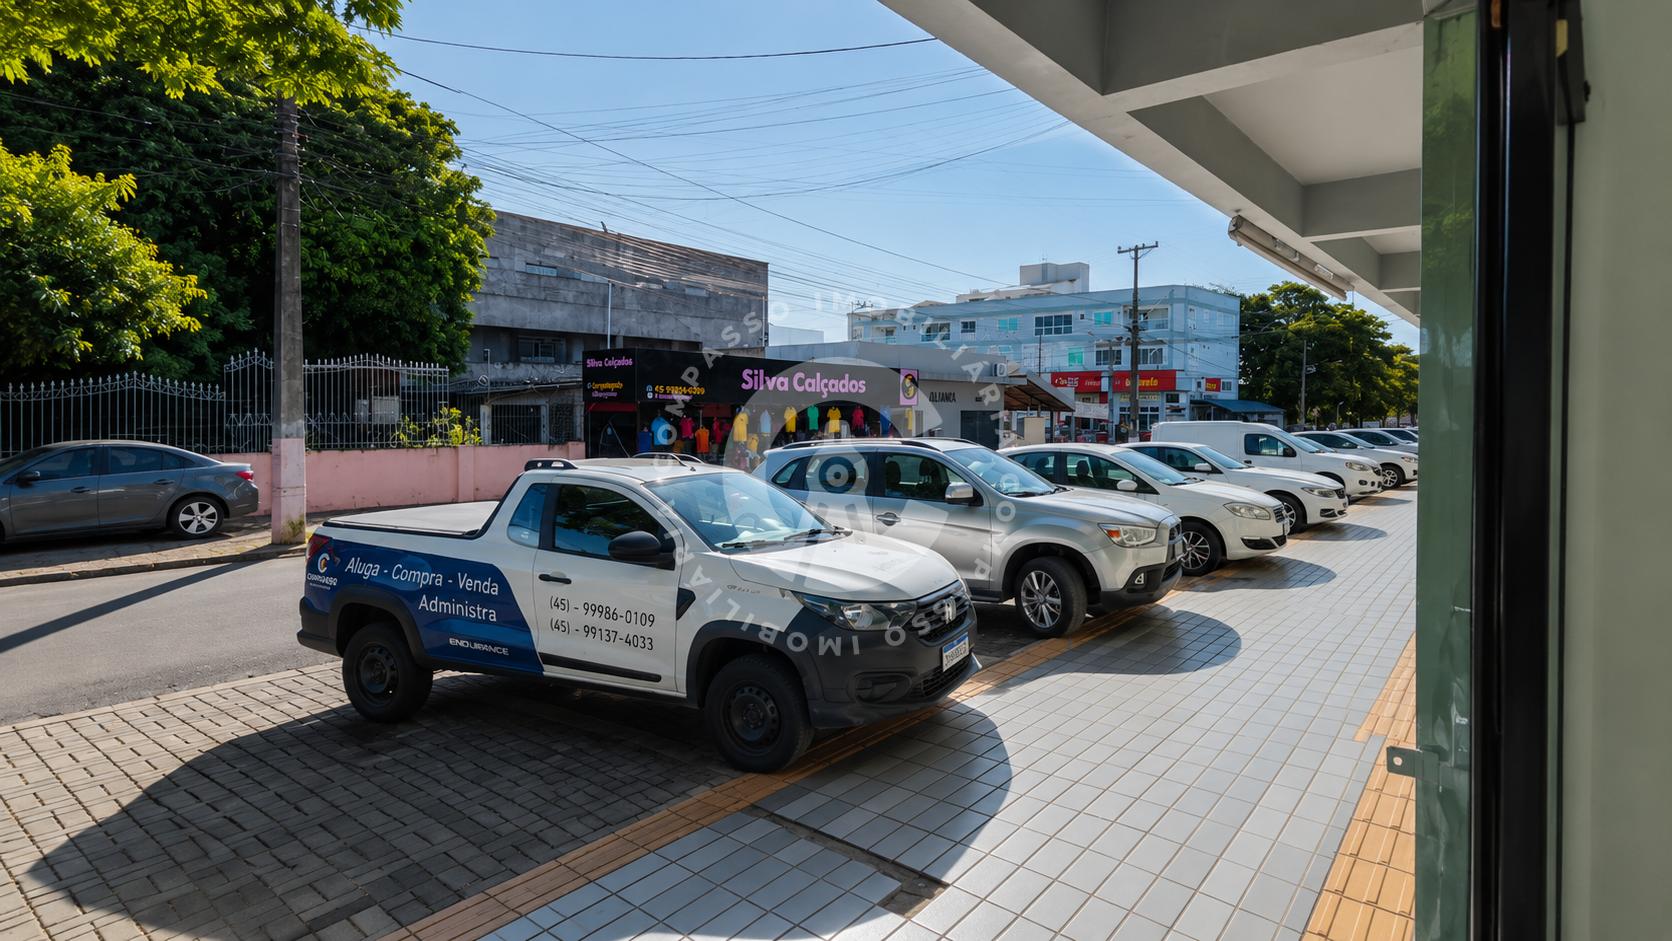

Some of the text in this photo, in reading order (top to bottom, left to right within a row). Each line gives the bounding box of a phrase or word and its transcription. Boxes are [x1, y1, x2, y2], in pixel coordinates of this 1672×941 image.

[741, 368, 866, 398] Silva Calçados
[345, 556, 381, 580] Aluga
[392, 563, 444, 588] Compra
[457, 572, 499, 596] Venda
[418, 595, 497, 622] Administra
[550, 595, 570, 613] (45)
[583, 602, 655, 628] 99986-0109
[449, 637, 510, 656] ENDURANCE
[550, 618, 570, 635] (45)
[583, 626, 654, 651] 99137-4033
